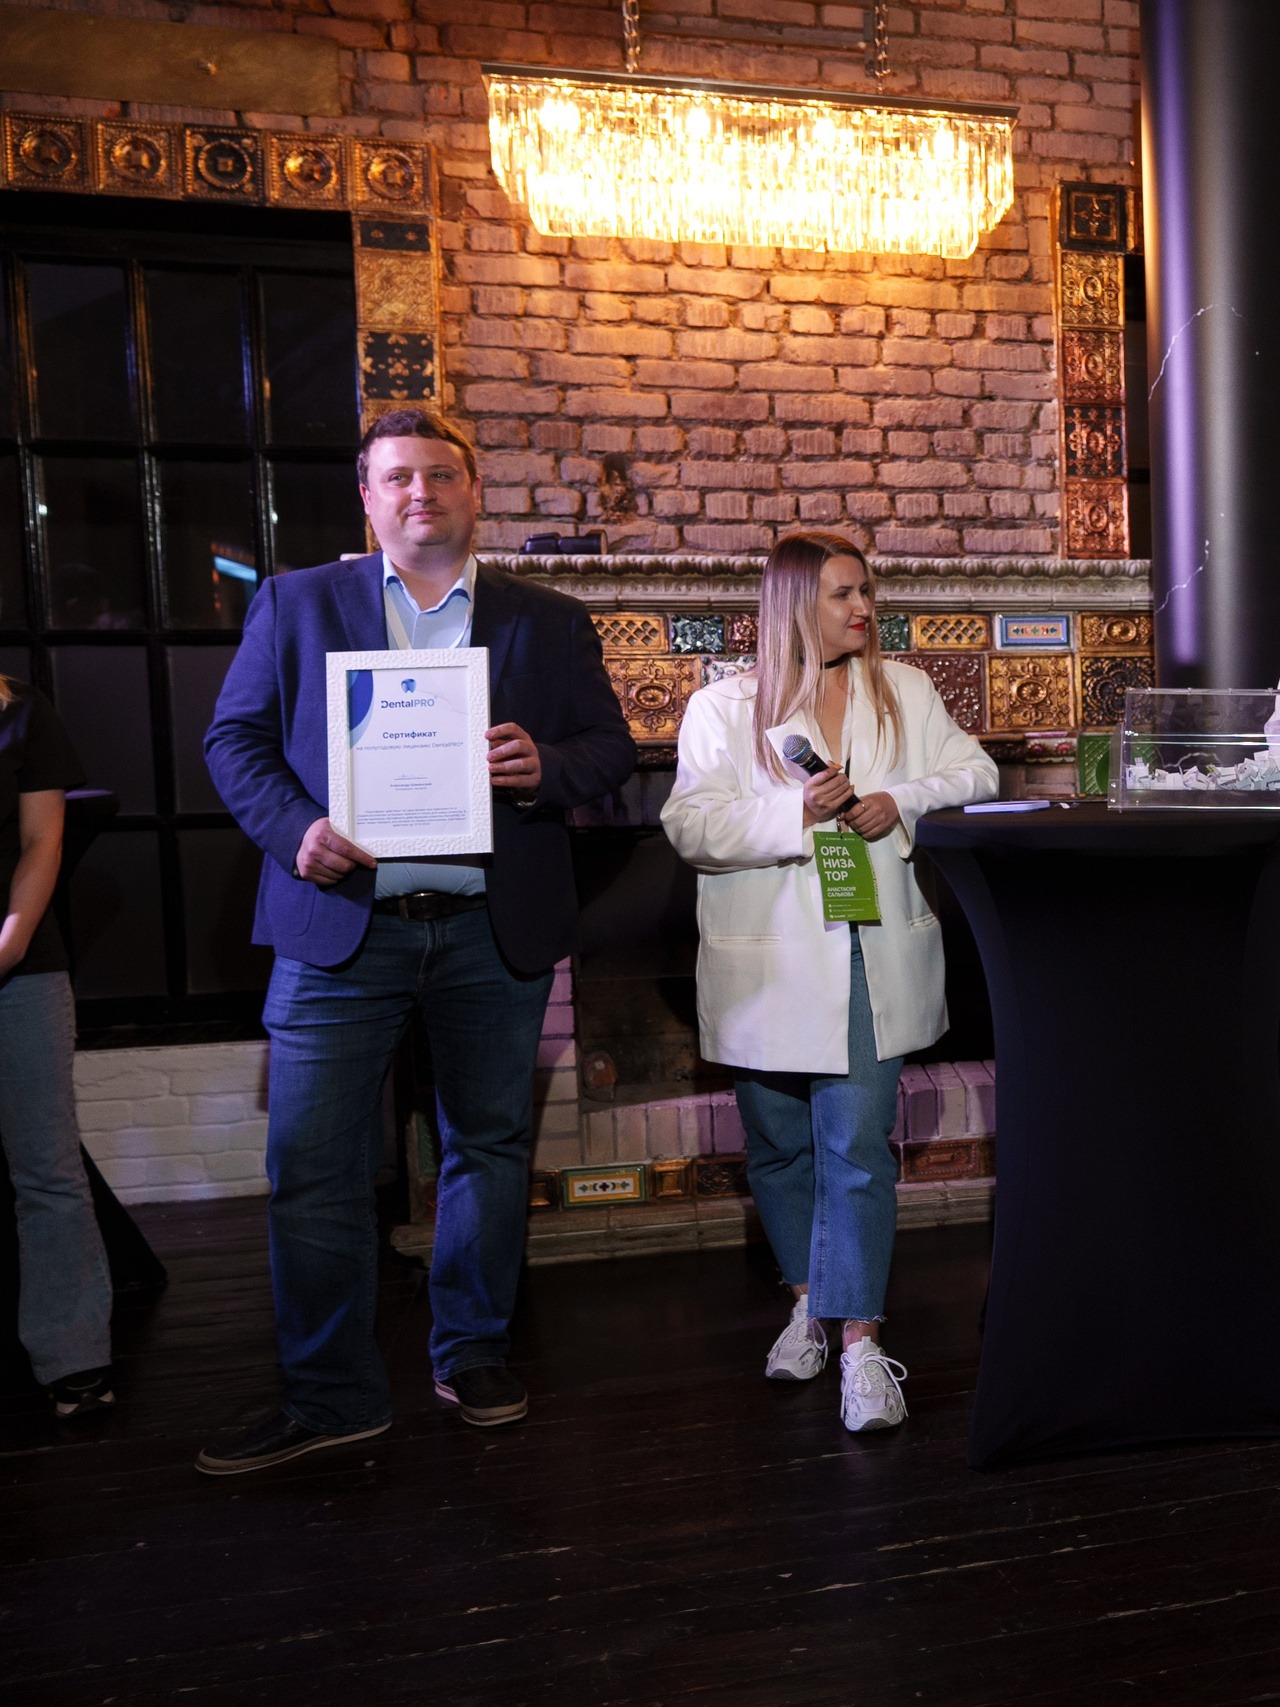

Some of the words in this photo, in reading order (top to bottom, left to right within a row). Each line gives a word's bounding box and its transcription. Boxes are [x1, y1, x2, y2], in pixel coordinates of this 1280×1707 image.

[381, 698, 435, 709] DentalPRO
[382, 731, 438, 741] Сертификат
[820, 845, 850, 856] ОРГА
[823, 858, 856, 869] НИЗА
[824, 870, 848, 881] ТОР
